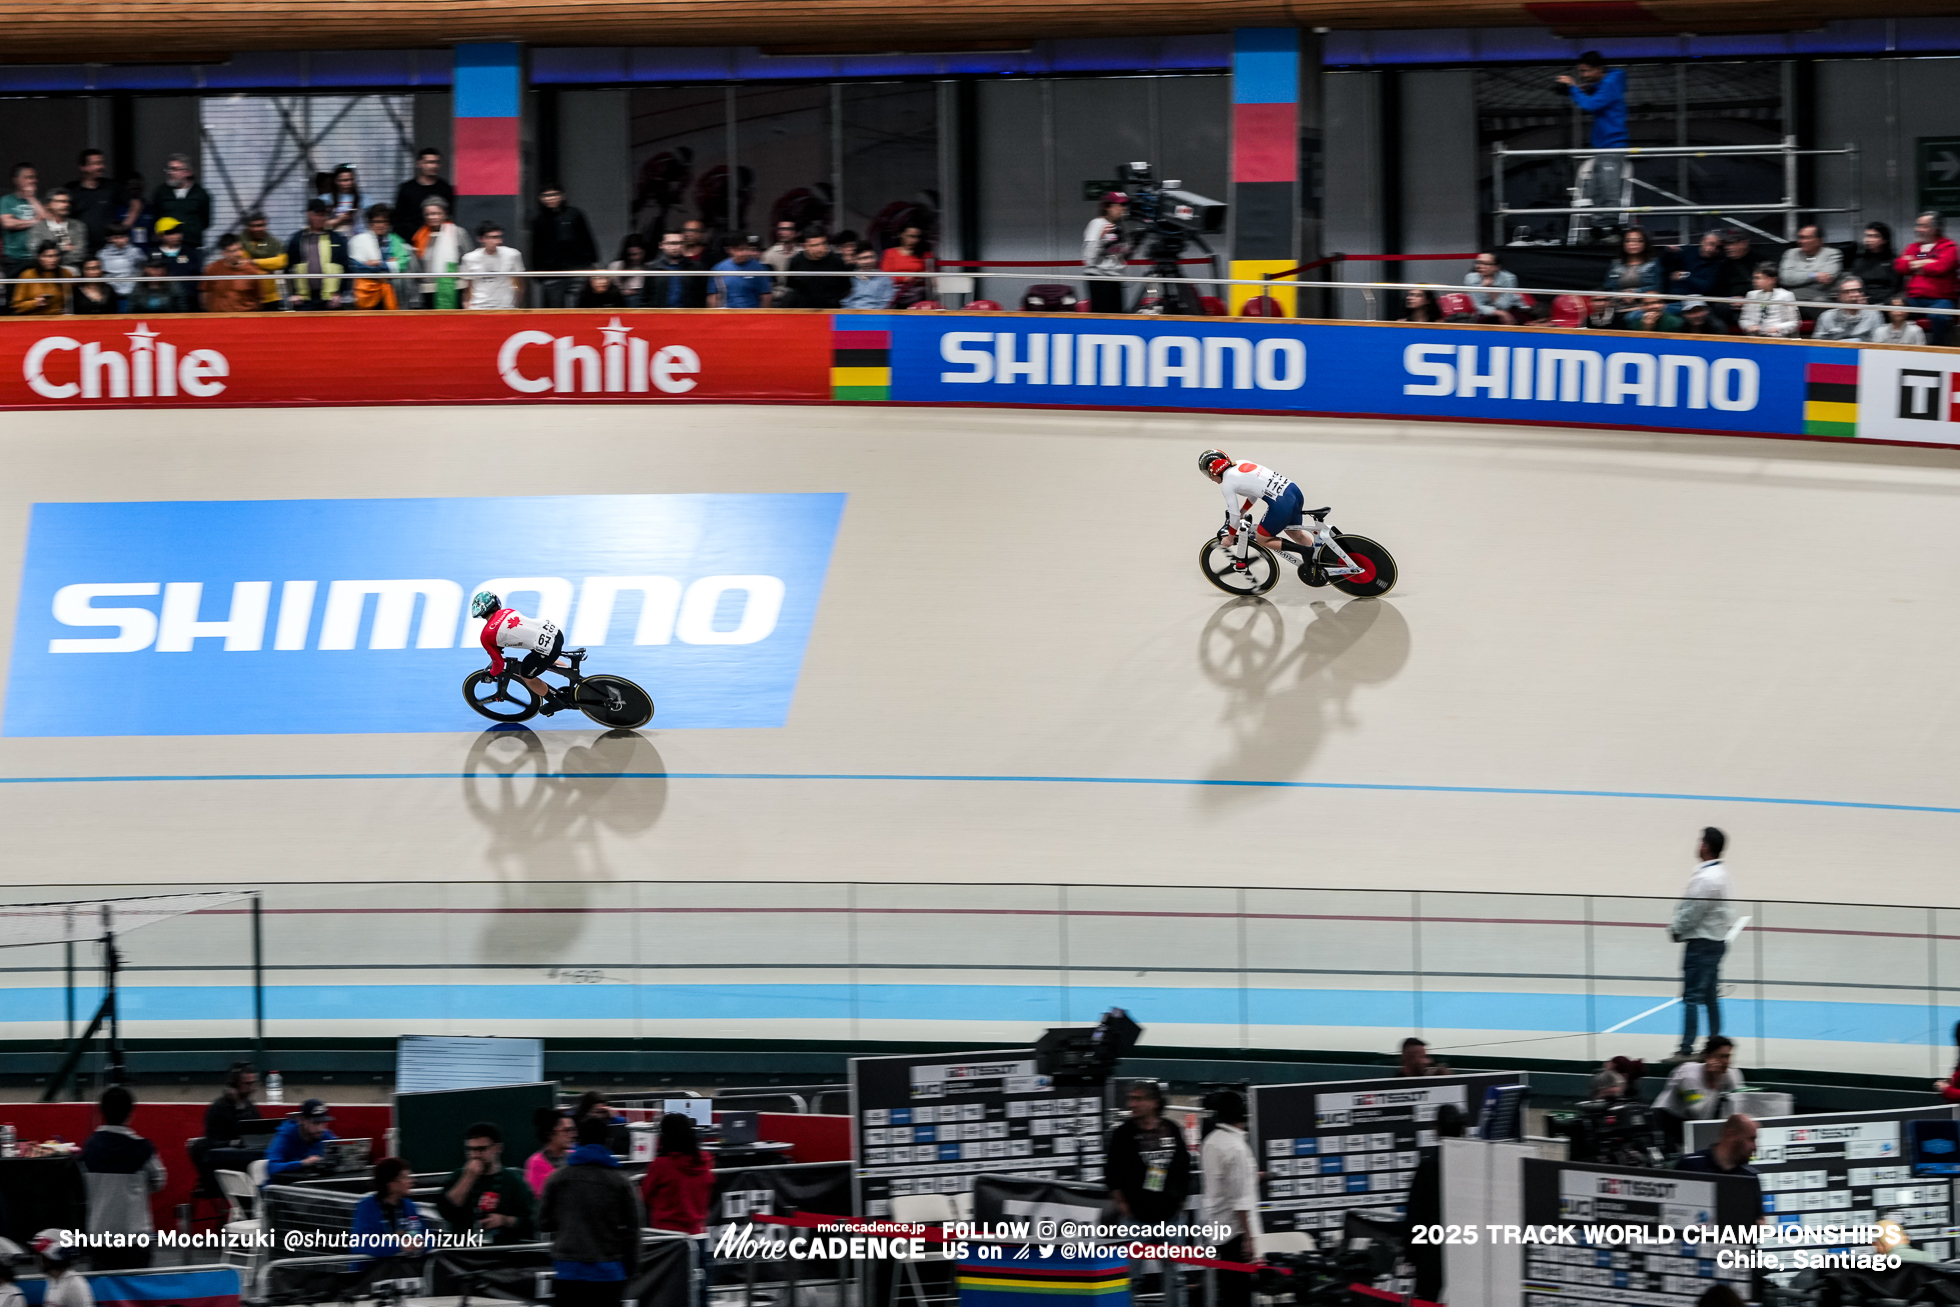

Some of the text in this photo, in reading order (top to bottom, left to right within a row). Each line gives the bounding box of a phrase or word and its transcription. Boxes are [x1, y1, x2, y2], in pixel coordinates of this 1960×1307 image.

[24, 321, 229, 399] Chile
[498, 317, 700, 397] Chile
[940, 330, 1307, 391] SHIMANO
[1403, 342, 1761, 413] SHIMANO
[48, 573, 787, 654] SHIMANO
[538, 633, 552, 648] 67
